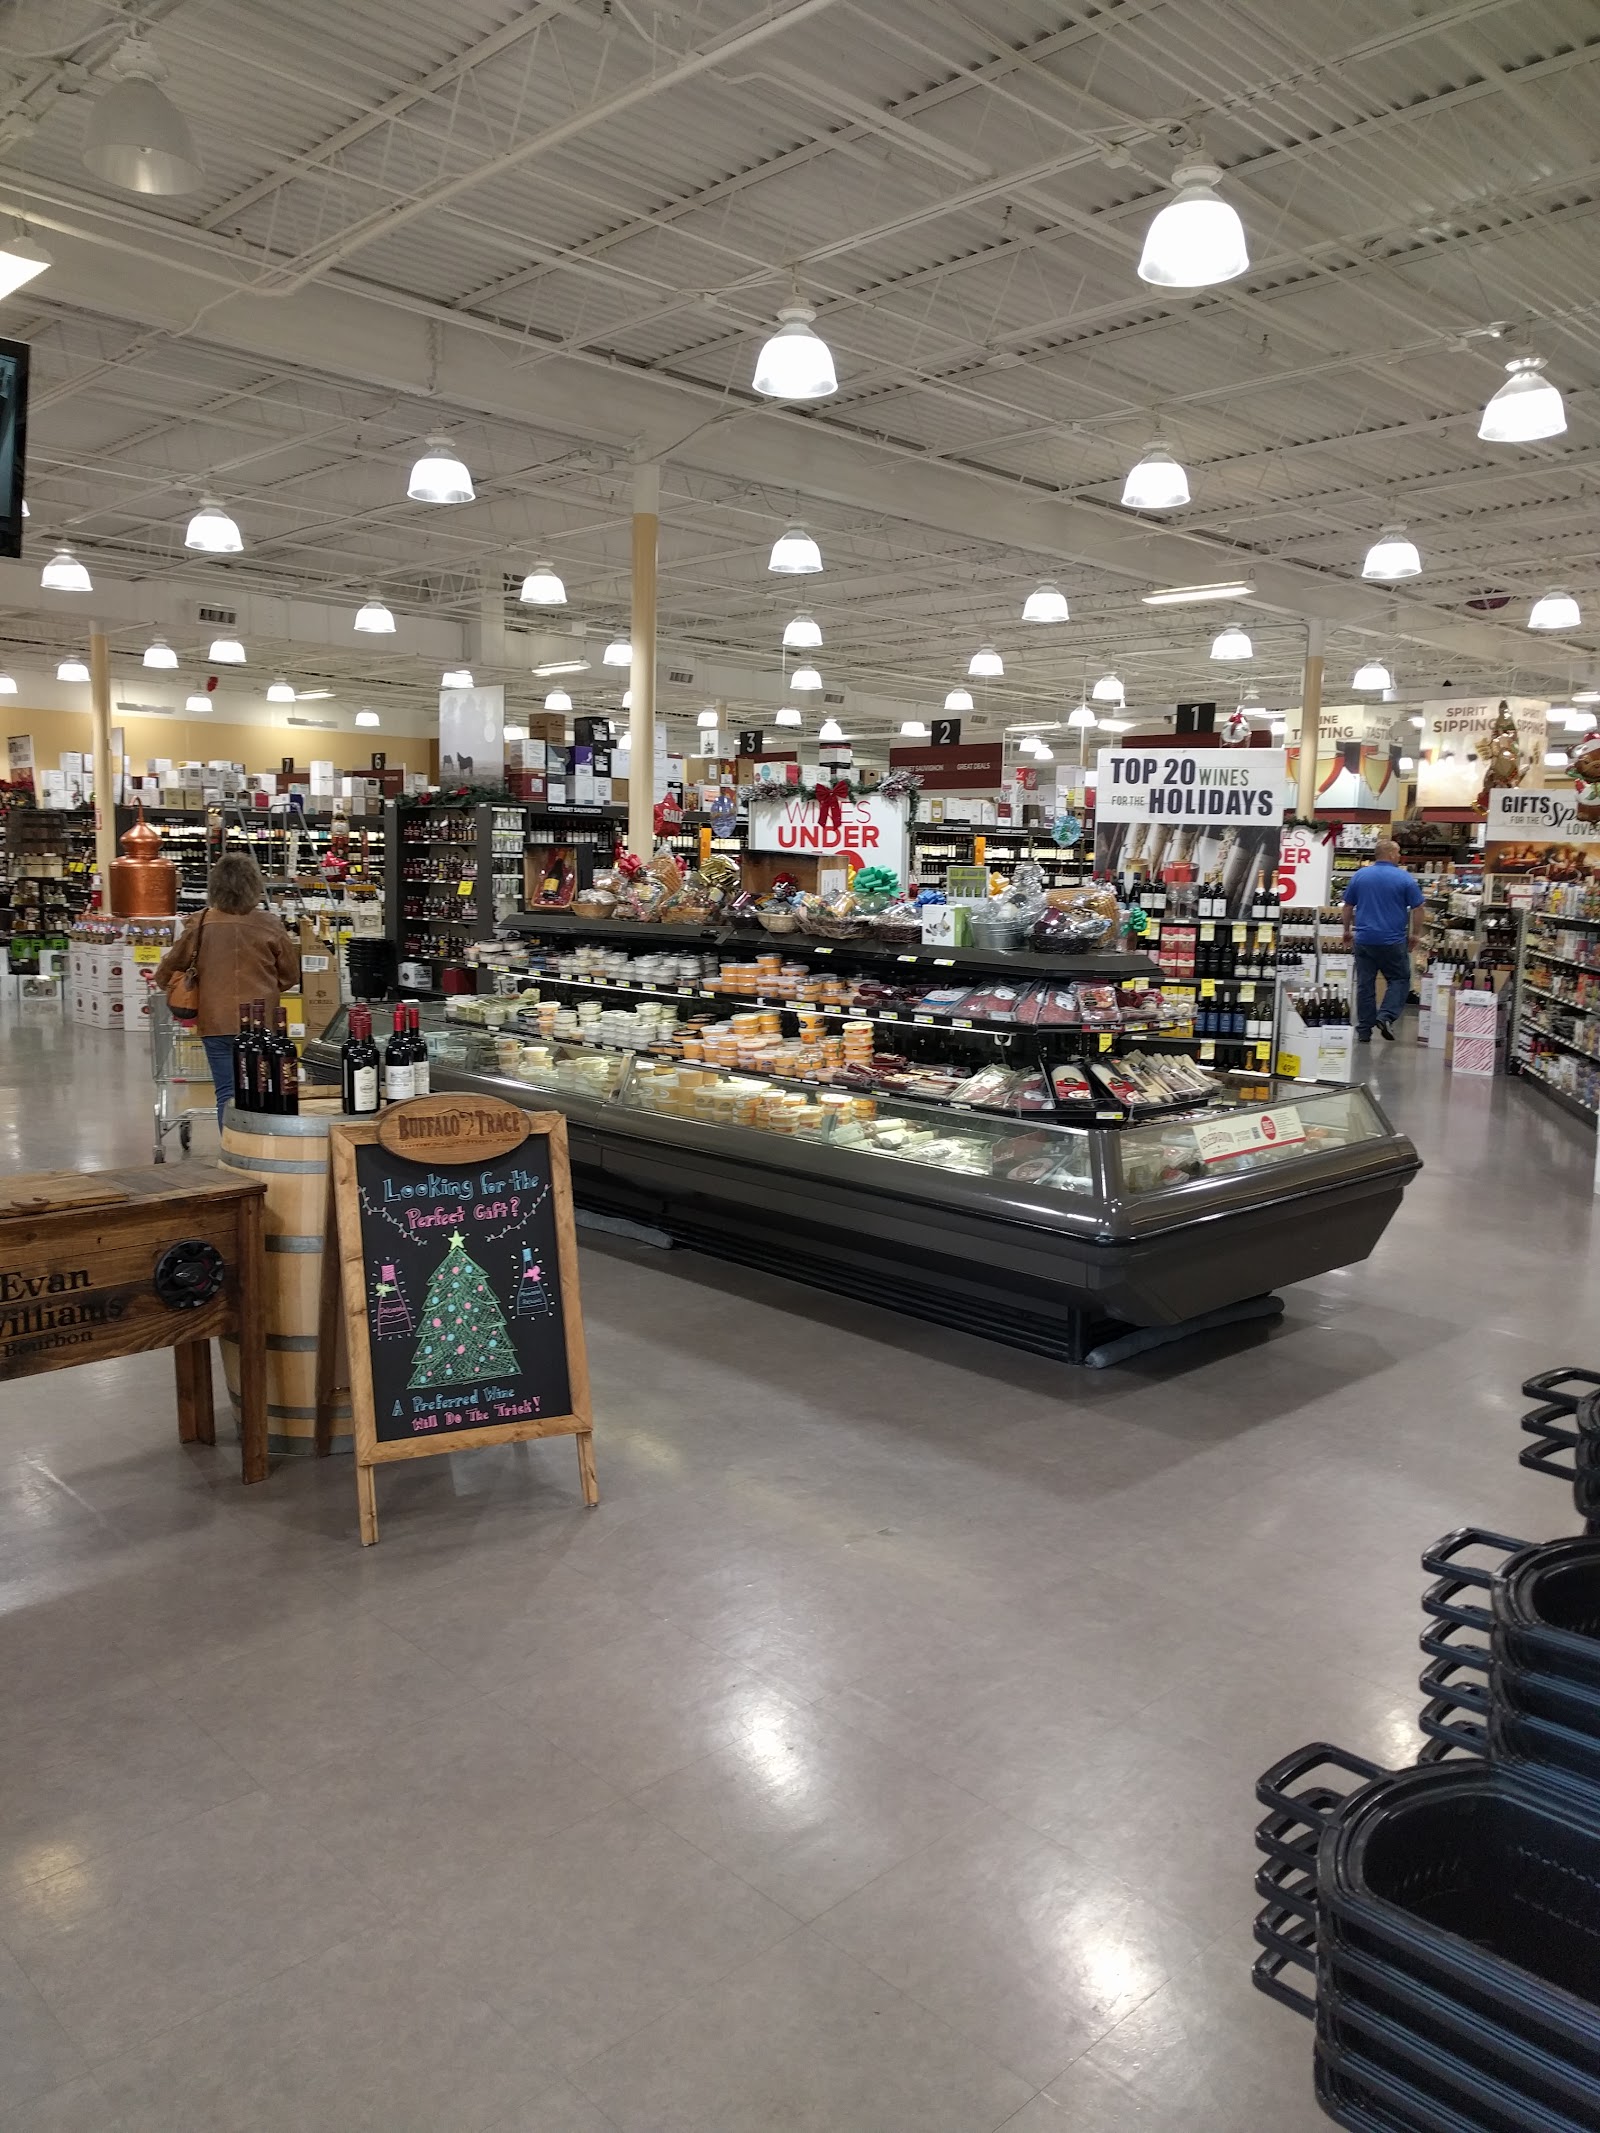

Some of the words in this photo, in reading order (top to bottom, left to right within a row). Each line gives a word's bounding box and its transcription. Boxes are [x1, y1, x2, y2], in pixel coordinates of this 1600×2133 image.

[1190, 705, 1200, 731] 1
[1319, 715, 1339, 724] INE
[1446, 706, 1488, 718] SPIRIT
[747, 733, 756, 753] 3
[940, 722, 951, 744] 2
[1292, 726, 1354, 740] TTING
[284, 758, 291, 773] 7
[375, 754, 382, 769] 6
[957, 763, 974, 771] GREAT
[974, 762, 991, 770] DEALS
[1110, 757, 1158, 785] TOP
[1163, 758, 1196, 786] 20
[1199, 768, 1250, 787] WINES
[784, 800, 872, 824] WIES
[1111, 795, 1128, 806] FOR
[1128, 795, 1145, 806] THE
[1149, 788, 1274, 816] HOLIDAYS
[1502, 795, 1551, 814] GIFTS
[1510, 816, 1525, 825] FOR
[1526, 816, 1541, 825] THE
[778, 826, 880, 848] UNDER
[398, 1114, 460, 1141] BUFFALO
[474, 1110, 520, 1136] TRACE
[382, 1172, 474, 1203] Looking
[480, 1171, 507, 1195] for
[508, 1169, 540, 1191] the
[405, 1205, 466, 1229] Perfect
[473, 1196, 521, 1220] Gift?
[0, 1269, 94, 1300] Evan
[391, 1399, 404, 1417] A
[412, 1389, 479, 1413] Preferred
[483, 1385, 516, 1402] Wine
[411, 1414, 439, 1431] Will
[444, 1411, 463, 1426] Do
[465, 1407, 490, 1422] The
[493, 1396, 541, 1417] Trick!
